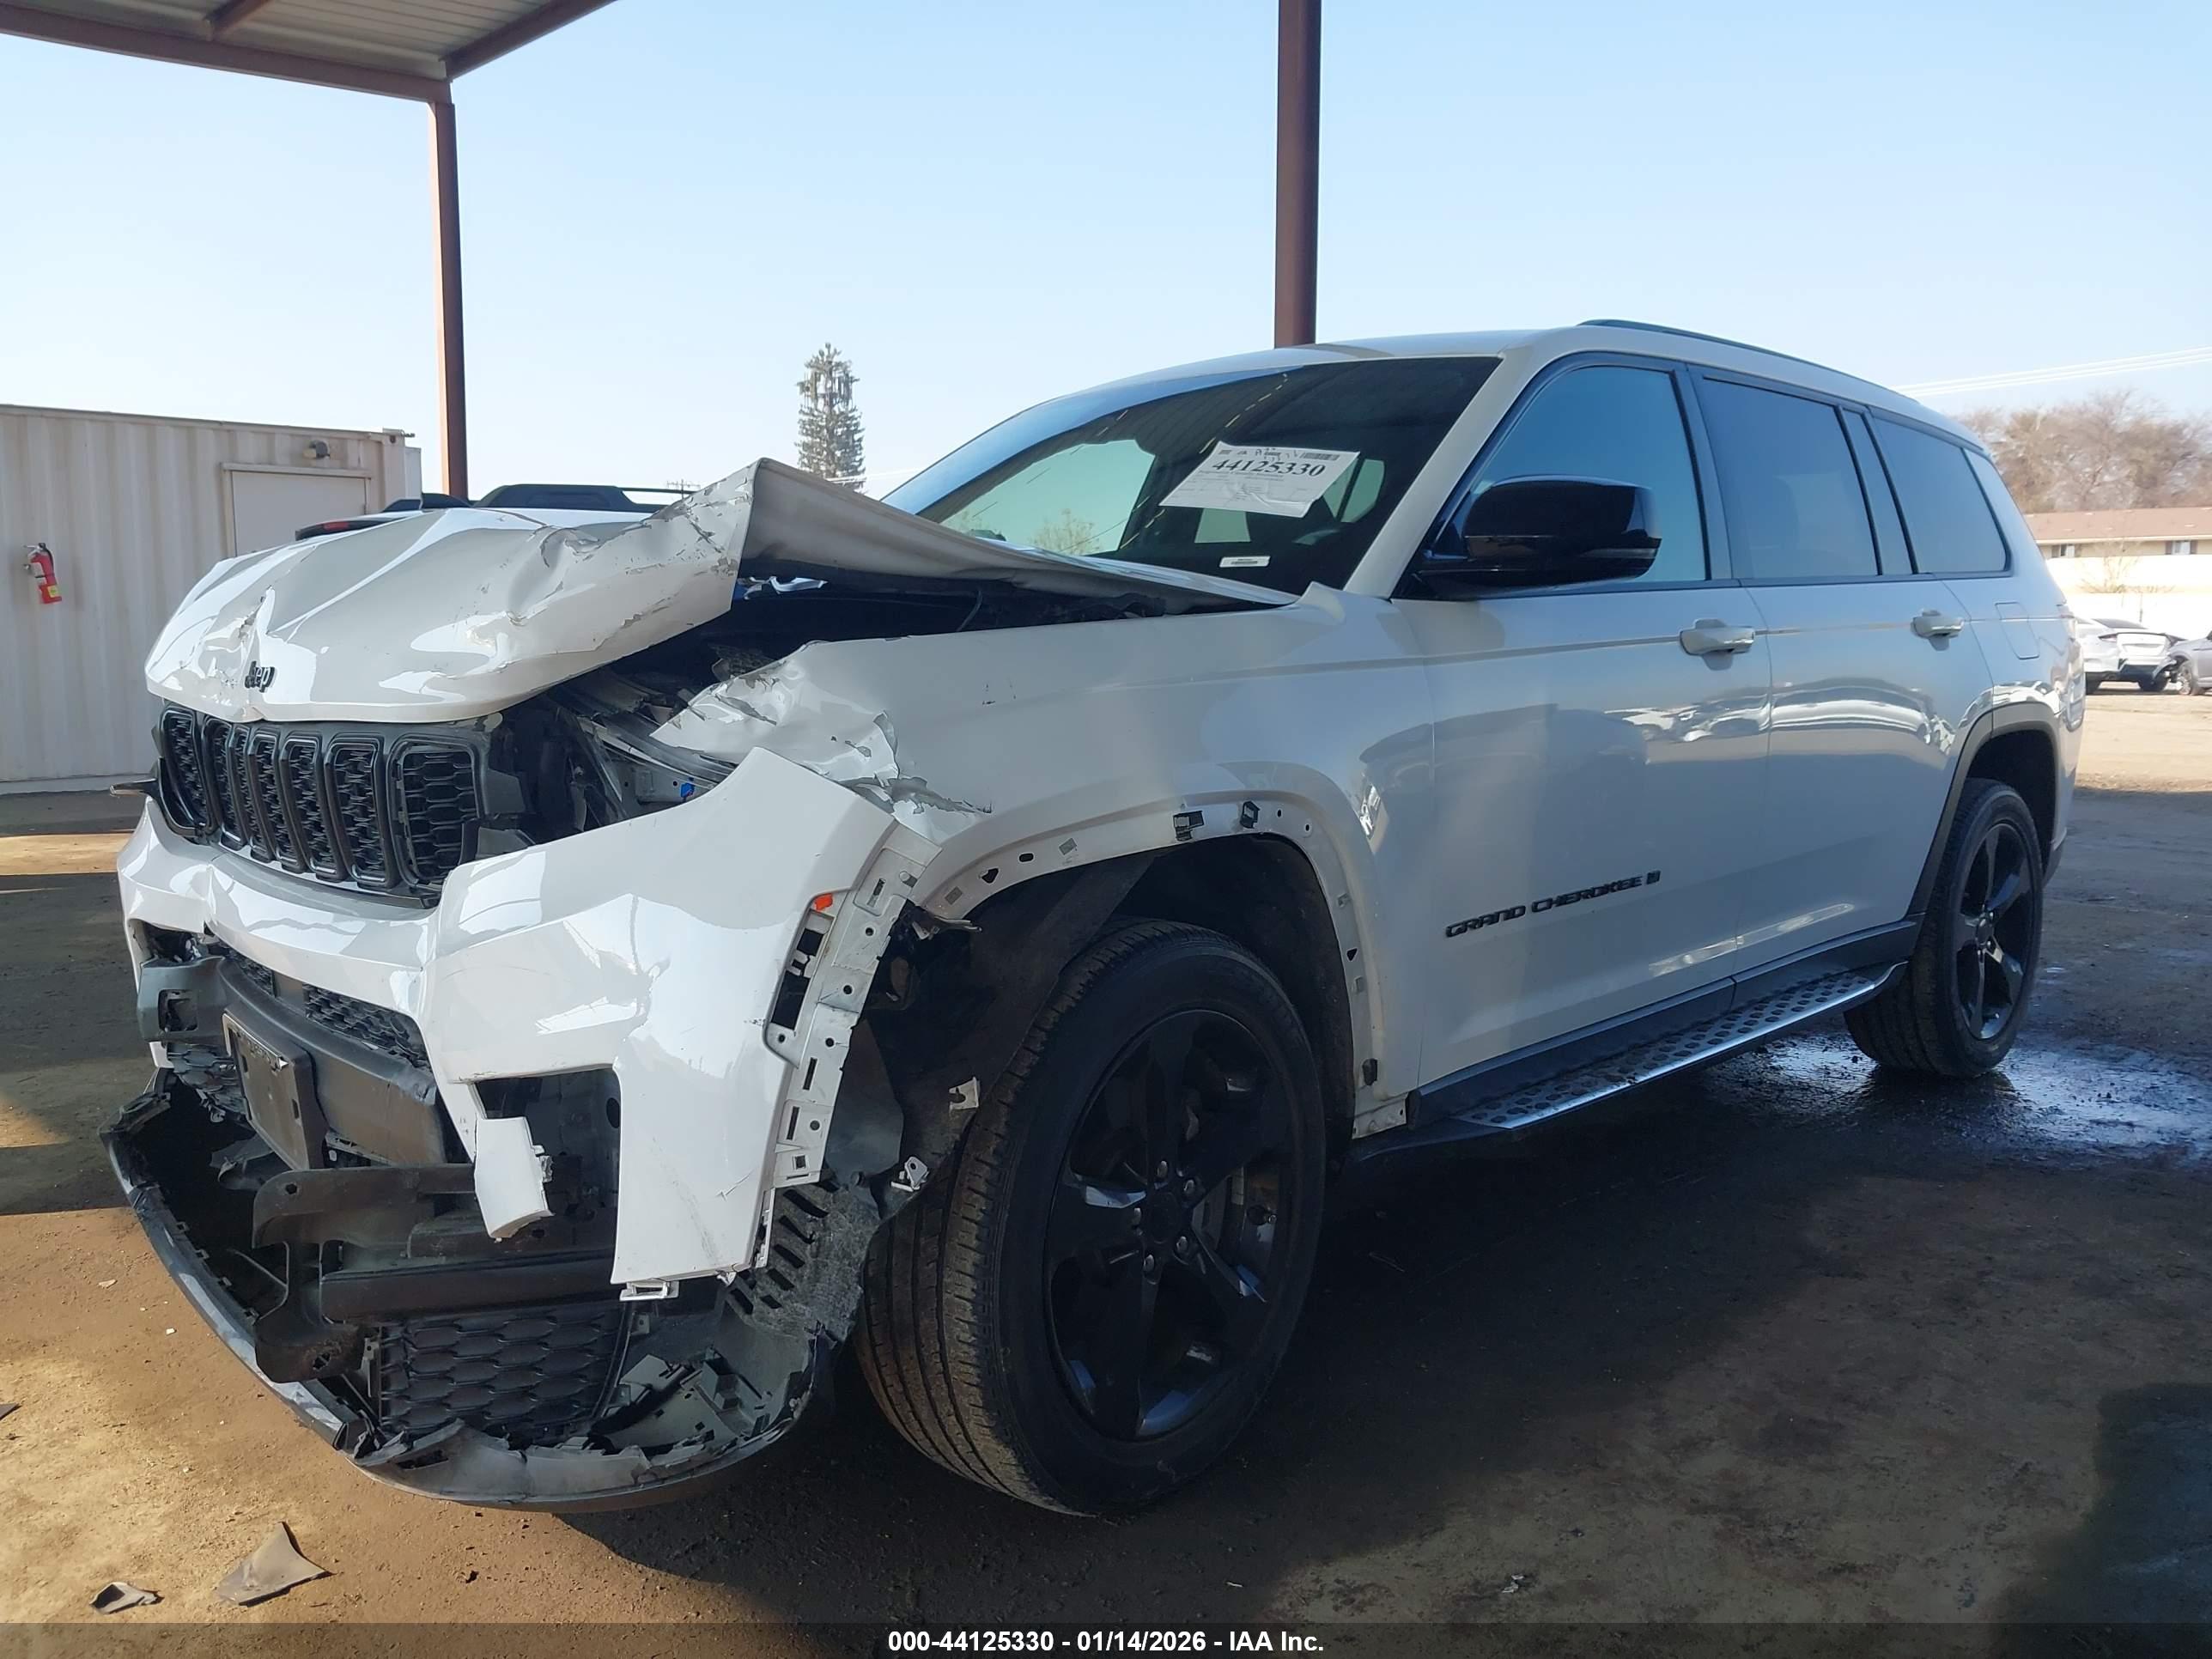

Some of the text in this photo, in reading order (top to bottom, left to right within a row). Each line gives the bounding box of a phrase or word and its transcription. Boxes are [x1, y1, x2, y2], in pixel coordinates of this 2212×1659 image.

[1212, 459, 1327, 477] 44125330
[1446, 905, 1526, 938] GRAND
[1531, 875, 1643, 914] CHEROKEE
